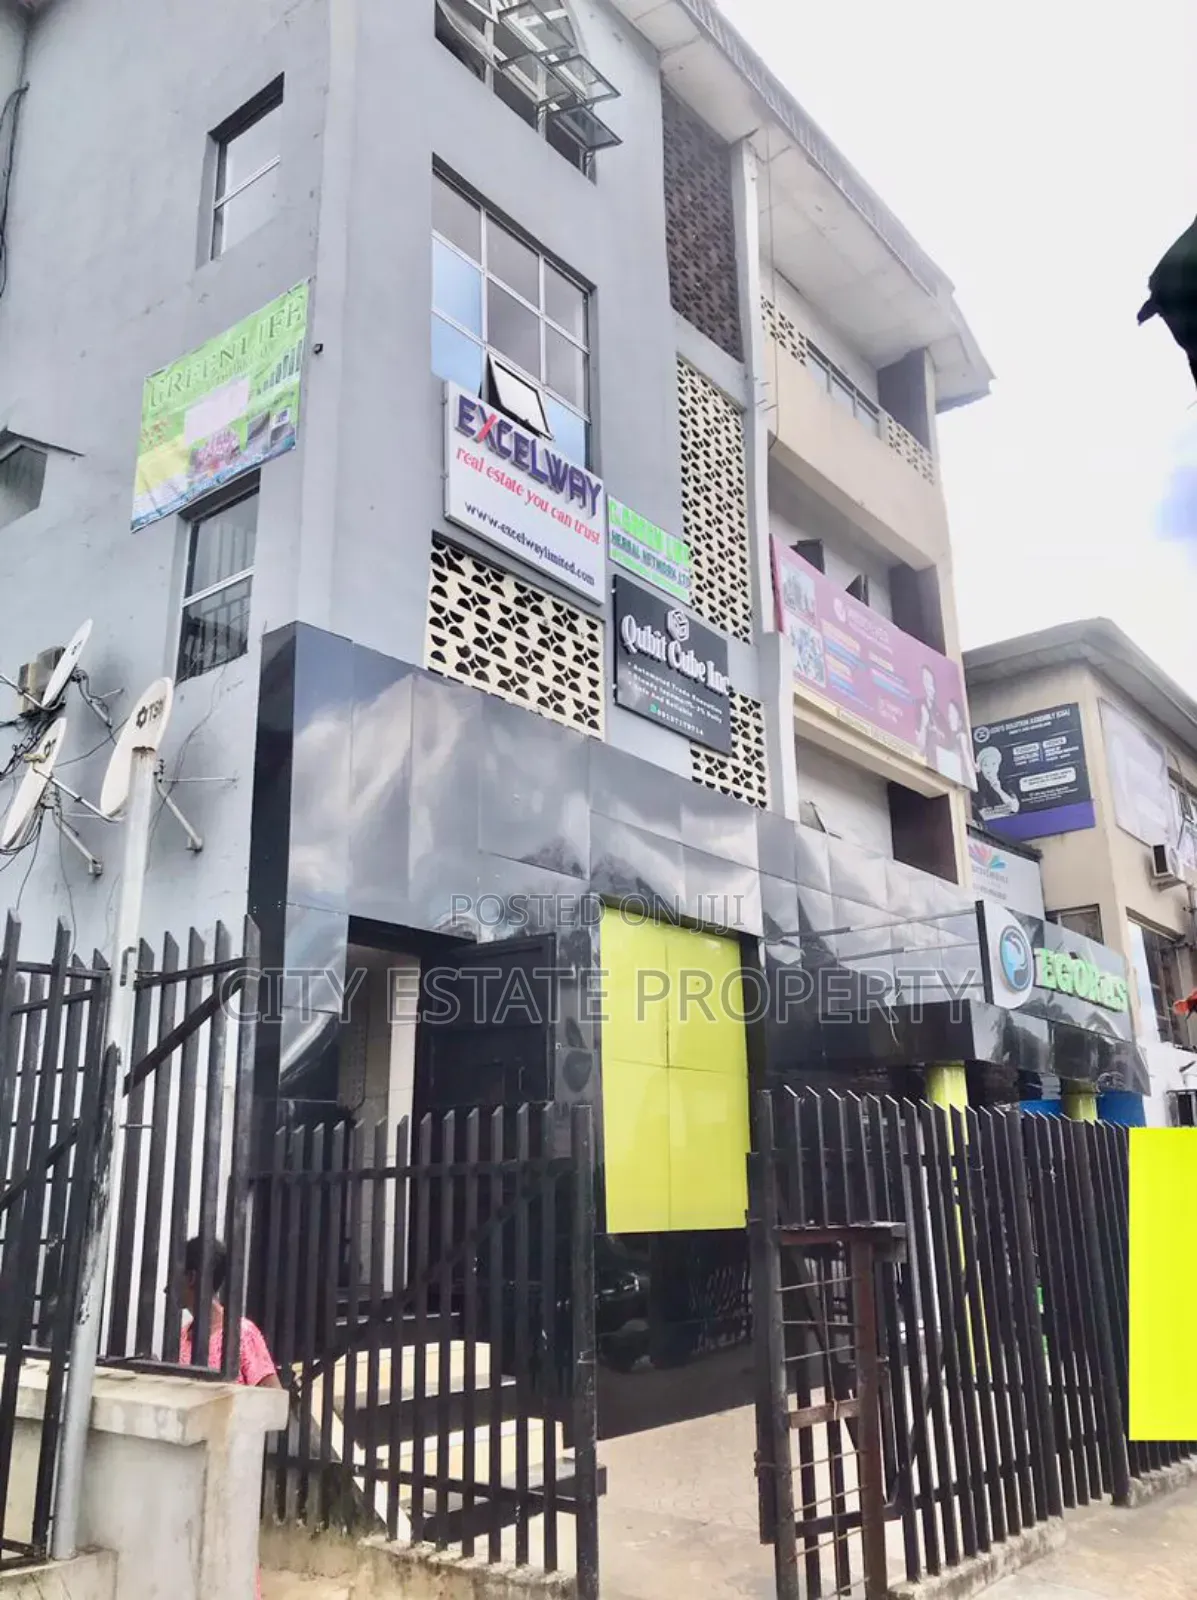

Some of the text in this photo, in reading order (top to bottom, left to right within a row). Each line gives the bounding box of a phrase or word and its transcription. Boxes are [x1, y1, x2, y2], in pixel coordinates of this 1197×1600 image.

[456, 395, 602, 518] EXCELWAY
[456, 447, 601, 546] real estate you can trust
[464, 501, 596, 587] www.excelwaylimited.com
[621, 614, 667, 662] Qubit
[668, 640, 706, 683] Cube
